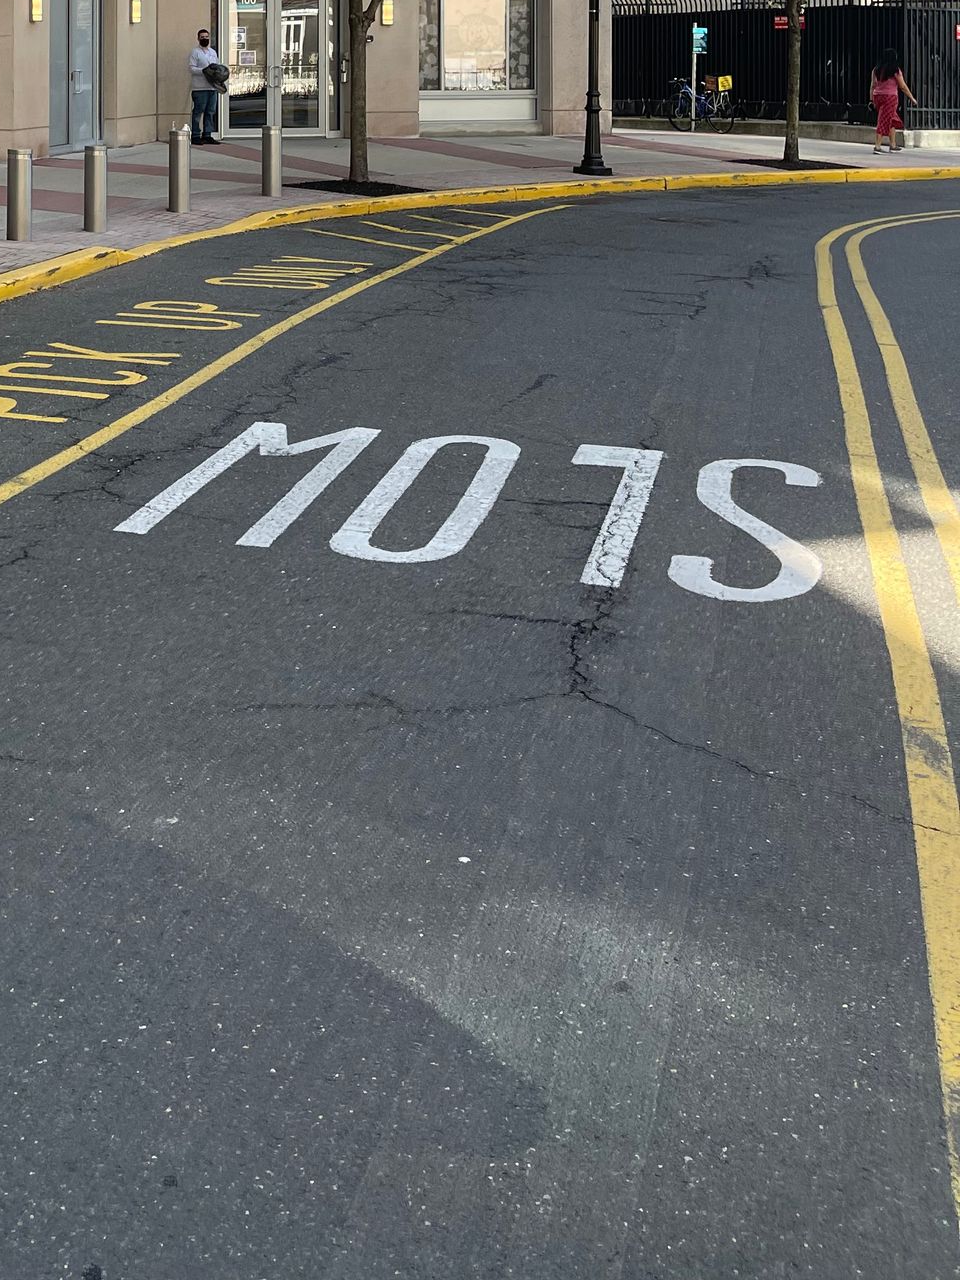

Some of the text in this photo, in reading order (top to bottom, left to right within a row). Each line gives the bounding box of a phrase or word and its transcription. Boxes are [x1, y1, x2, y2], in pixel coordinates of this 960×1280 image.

[95, 300, 261, 330] UP
[204, 255, 374, 290] ONLY
[113, 422, 823, 602] SLOW
